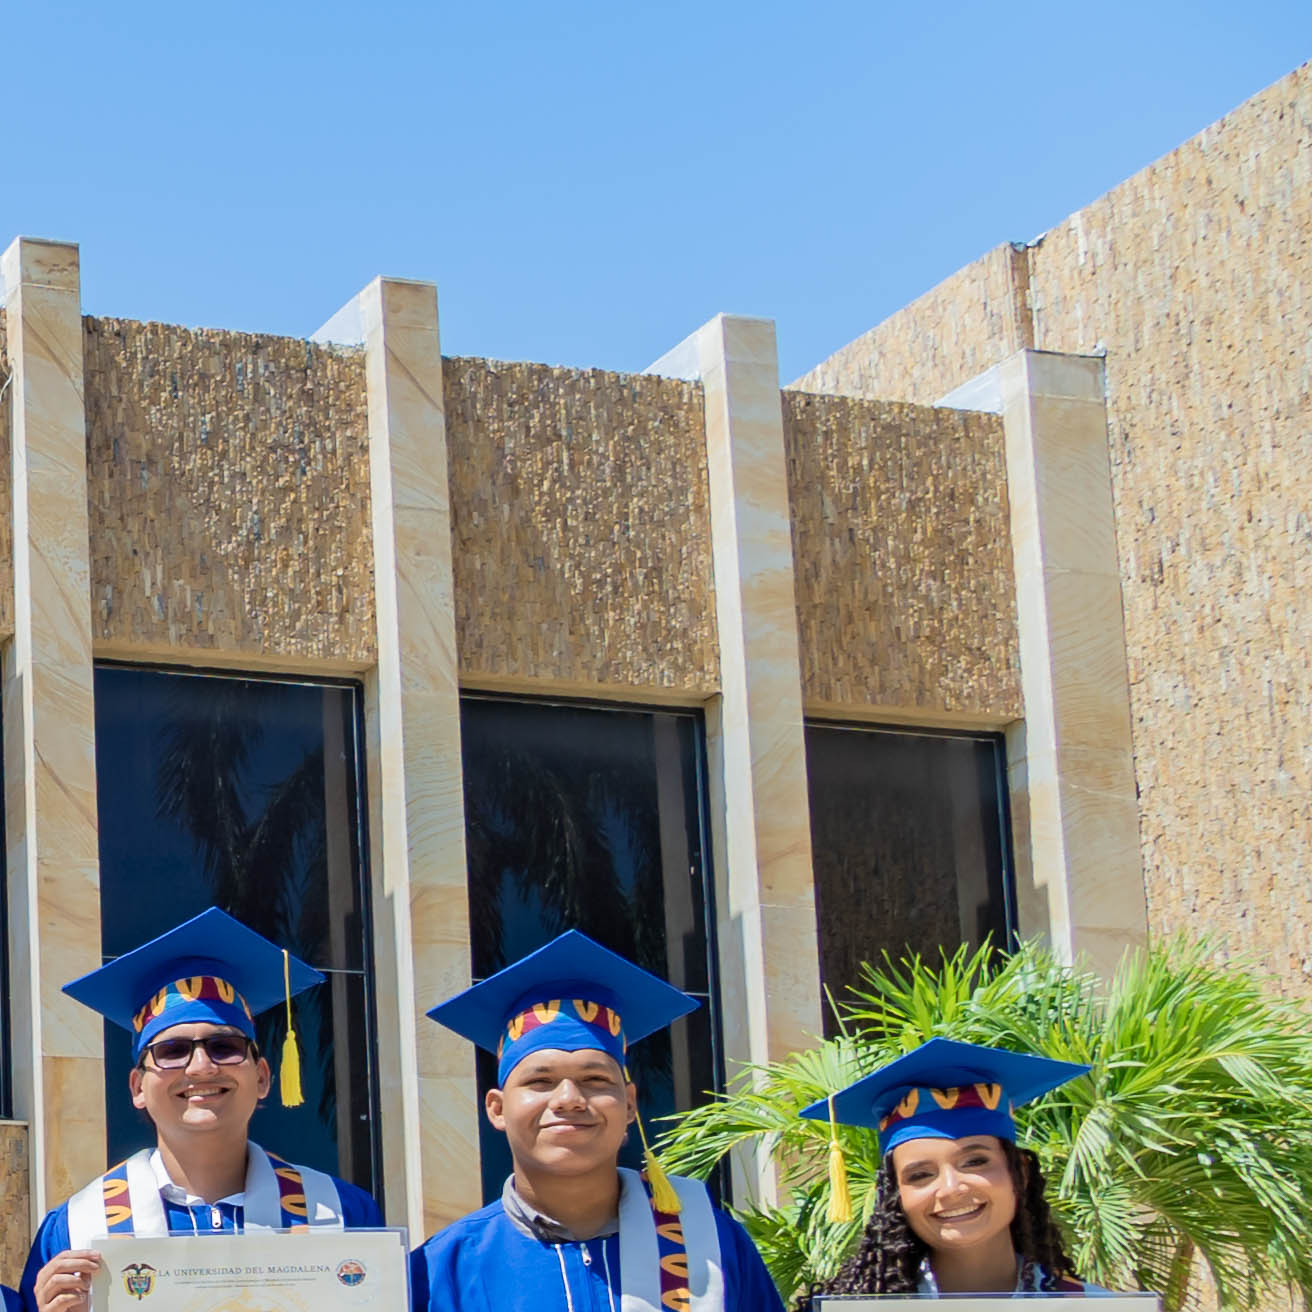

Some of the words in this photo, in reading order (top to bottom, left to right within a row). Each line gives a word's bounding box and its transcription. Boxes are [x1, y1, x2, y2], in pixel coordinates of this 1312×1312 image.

[158, 1269, 170, 1277] LA
[174, 1268, 242, 1277] UNIVERSIDAD
[245, 1266, 264, 1274] DEL
[268, 1265, 330, 1274] MAGDALENA
